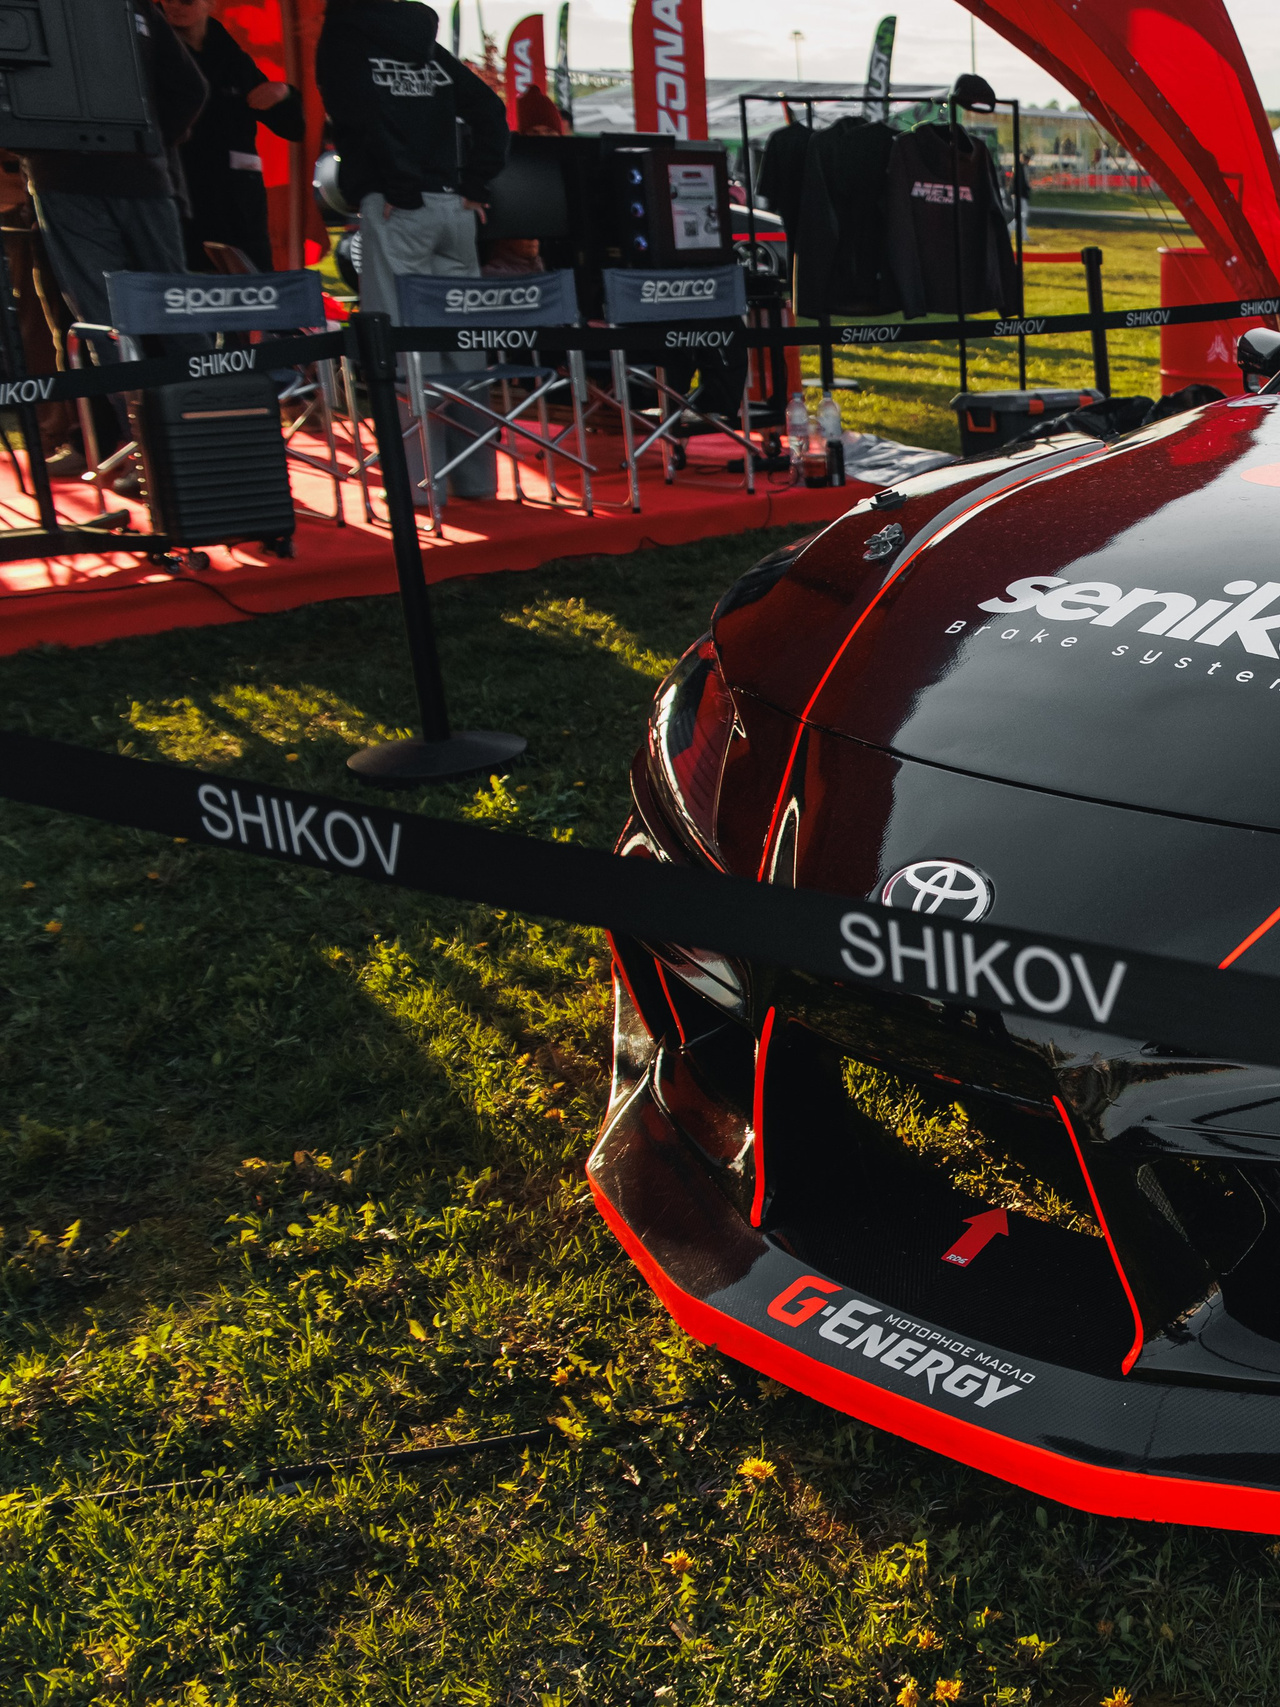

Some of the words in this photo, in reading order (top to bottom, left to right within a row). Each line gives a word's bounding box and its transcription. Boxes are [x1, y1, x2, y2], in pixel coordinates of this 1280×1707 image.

[164, 286, 279, 313] sparco
[445, 285, 540, 314] sparco
[640, 278, 716, 303] sparco
[1125, 309, 1171, 327] SHIKOV
[1240, 300, 1280, 317] SHIKOV
[457, 330, 538, 349] SHIKOV
[664, 330, 734, 348] SHIKOV
[840, 325, 900, 344] SHIKOV
[993, 318, 1047, 337] SHIKOV
[188, 349, 257, 378] SHIKOV
[0, 377, 55, 405] IKOV
[944, 620, 1078, 648] Brake
[197, 783, 401, 876] SHIKOV
[838, 911, 1127, 1024] SHIKOV
[884, 1313, 976, 1359] МОТОРНОЕ
[974, 1352, 1036, 1385] МАСЛО
